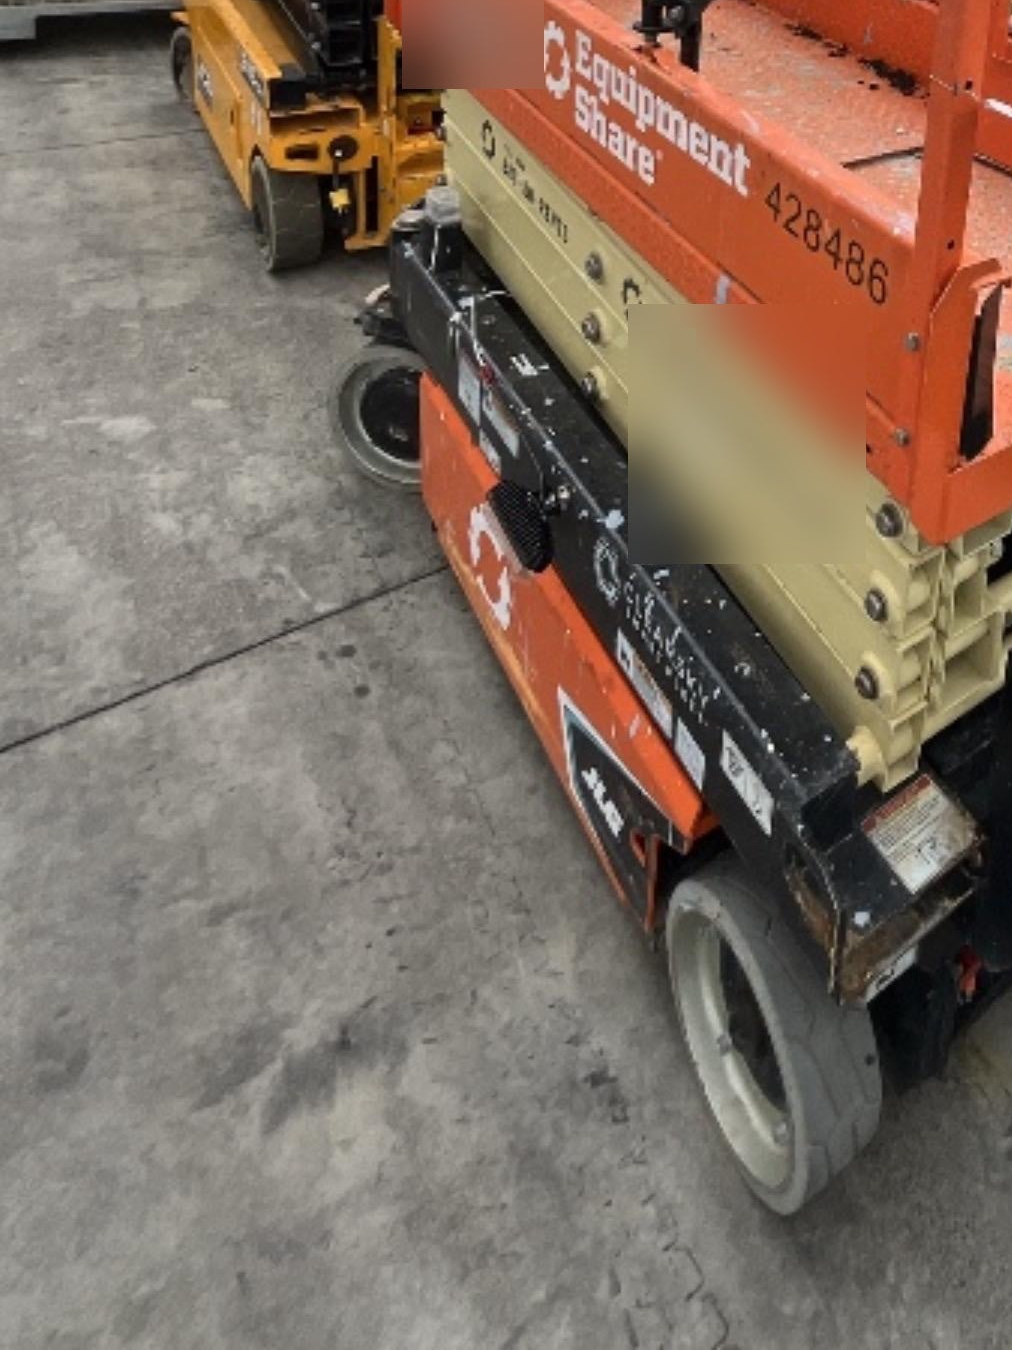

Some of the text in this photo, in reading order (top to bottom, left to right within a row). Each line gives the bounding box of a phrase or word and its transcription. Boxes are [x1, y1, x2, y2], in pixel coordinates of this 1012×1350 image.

[574, 28, 751, 198] Equipment
[574, 84, 656, 187] Share
[764, 181, 890, 306] 428486
